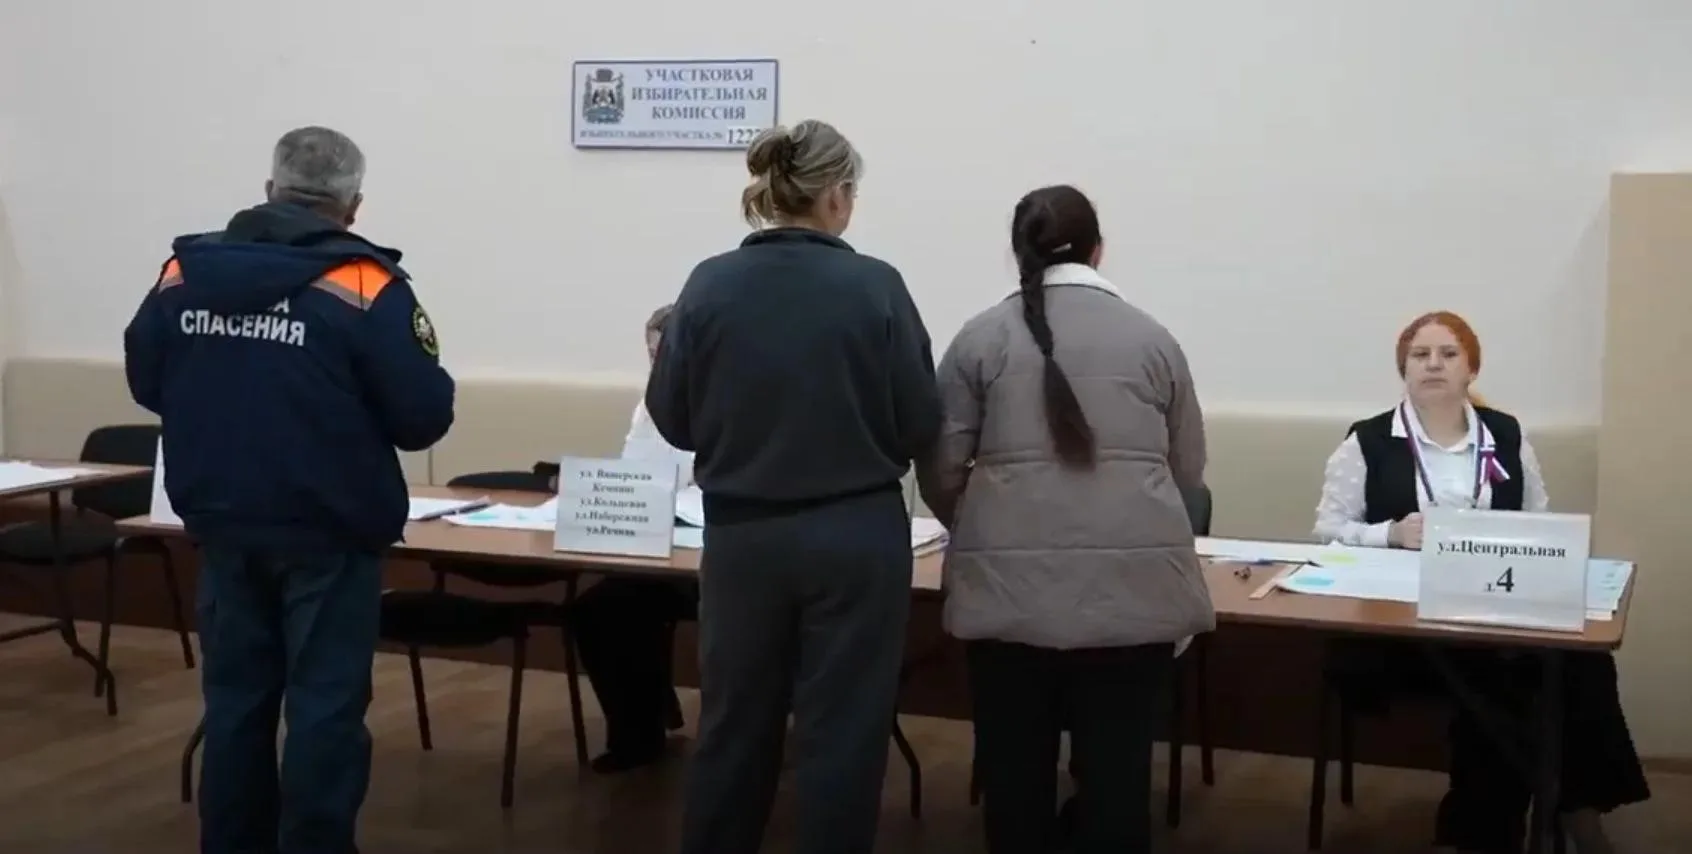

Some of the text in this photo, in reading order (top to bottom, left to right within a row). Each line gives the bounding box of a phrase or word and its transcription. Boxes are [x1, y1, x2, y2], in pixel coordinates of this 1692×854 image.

[645, 68, 754, 82] УЧАСТКОВАЯ
[632, 87, 767, 101] ИЗБИРАТЕЛЬНАЯ
[652, 106, 746, 120] КОМИССИЯ
[180, 309, 305, 346] СПАСЕНИЯ
[1437, 540, 1566, 558] ул.Центральная
